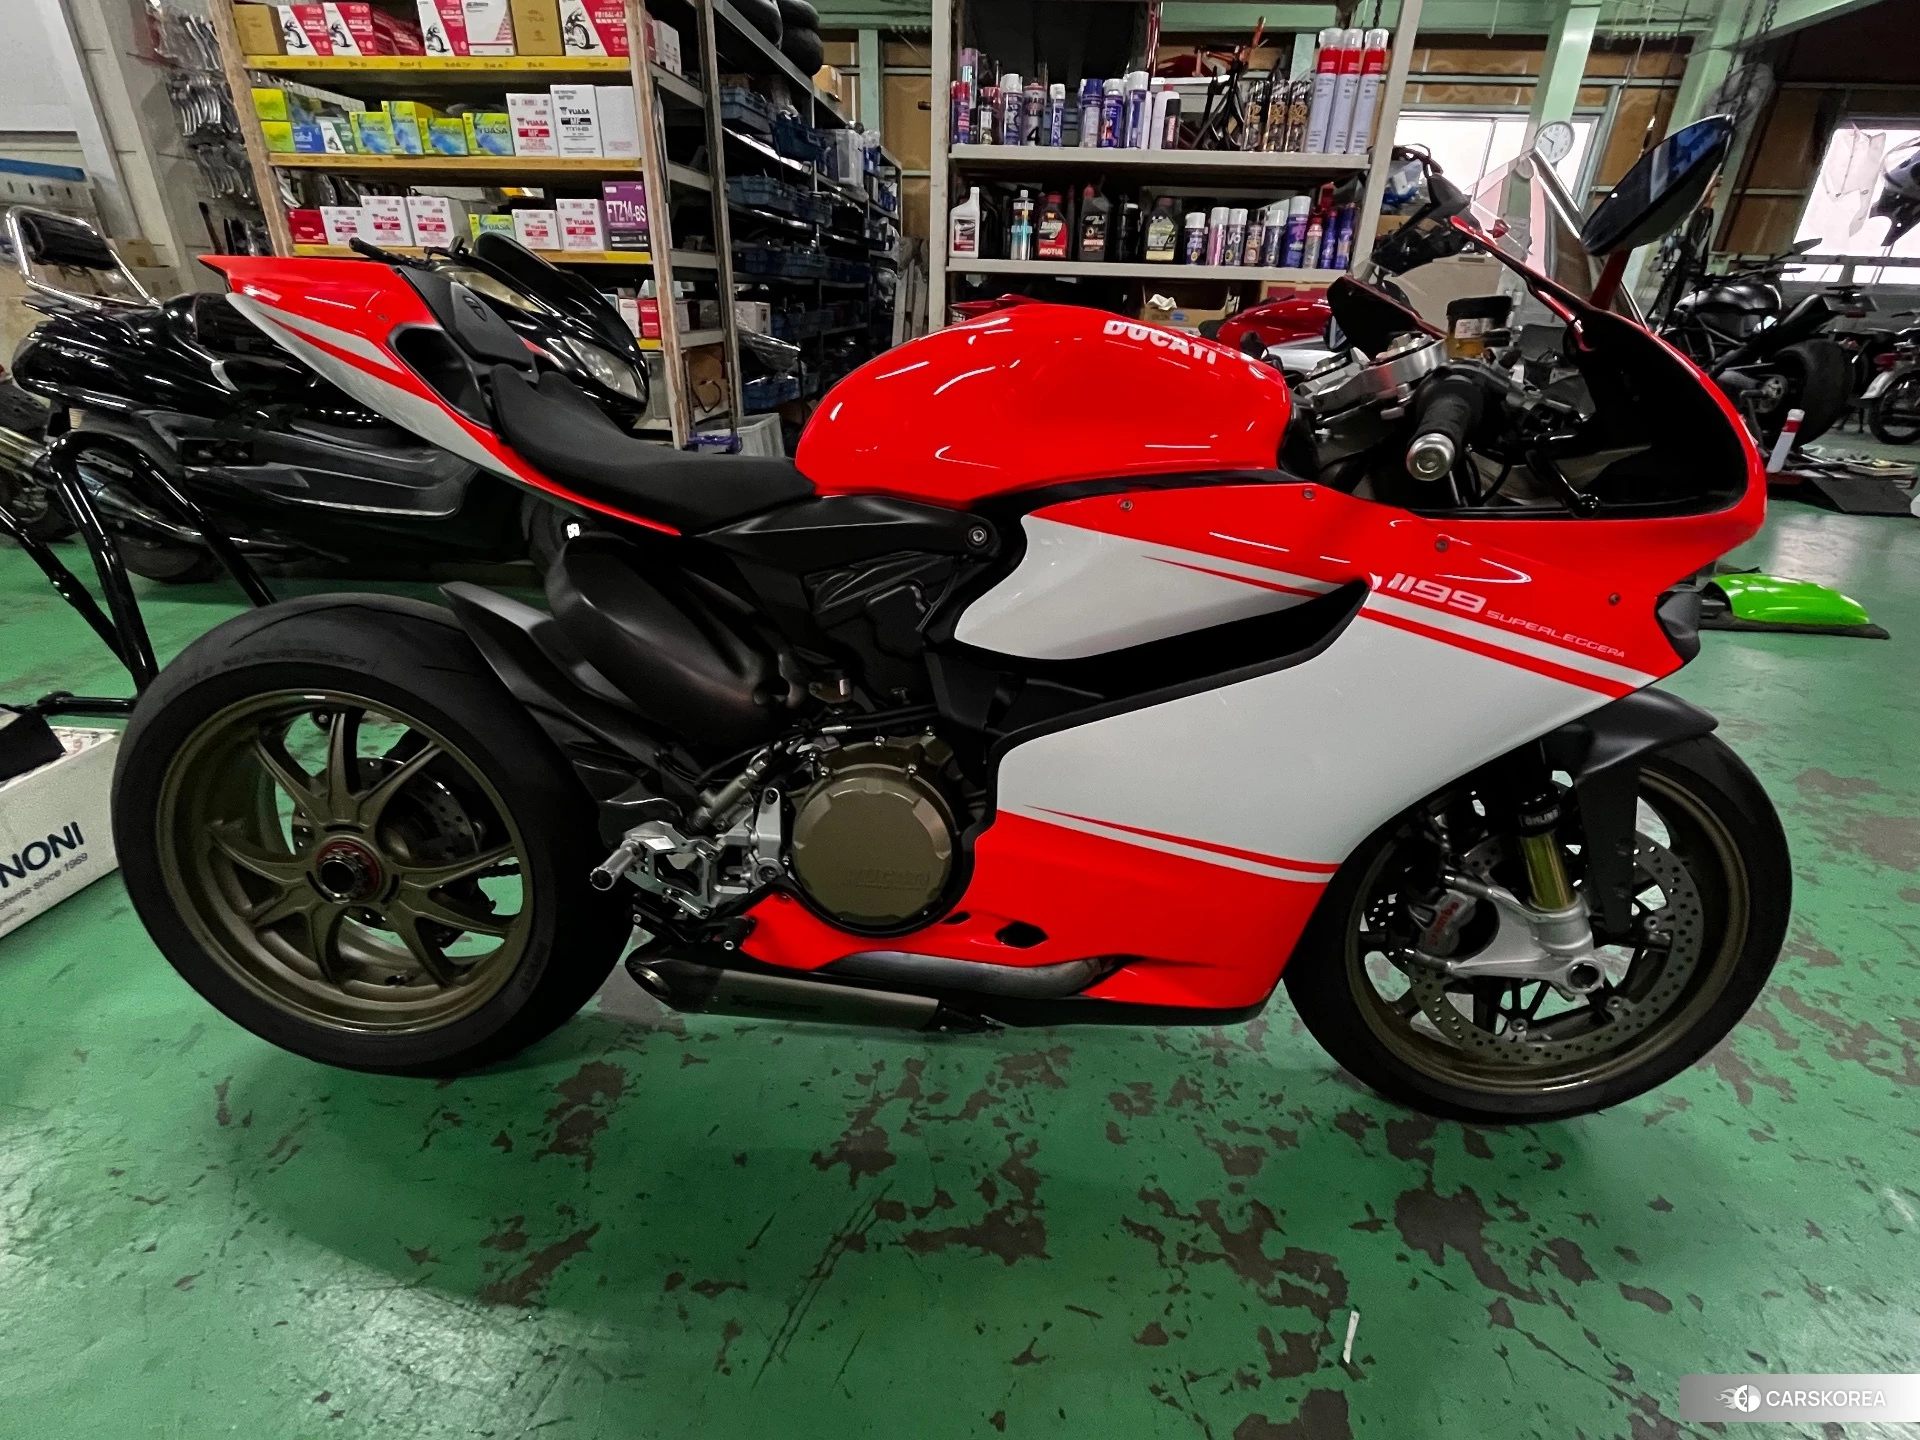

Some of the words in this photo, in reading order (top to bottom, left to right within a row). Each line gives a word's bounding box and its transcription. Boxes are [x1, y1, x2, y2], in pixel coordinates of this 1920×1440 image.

[479, 127, 508, 135] YUASA
[606, 201, 646, 222] FTZ14-BS
[1039, 247, 1064, 255] MOTUL
[1103, 319, 1217, 365] DUCATI
[1387, 572, 1487, 614] 1199
[1486, 609, 1626, 659] SUPERLEGGERA
[33, 869, 62, 890] since
